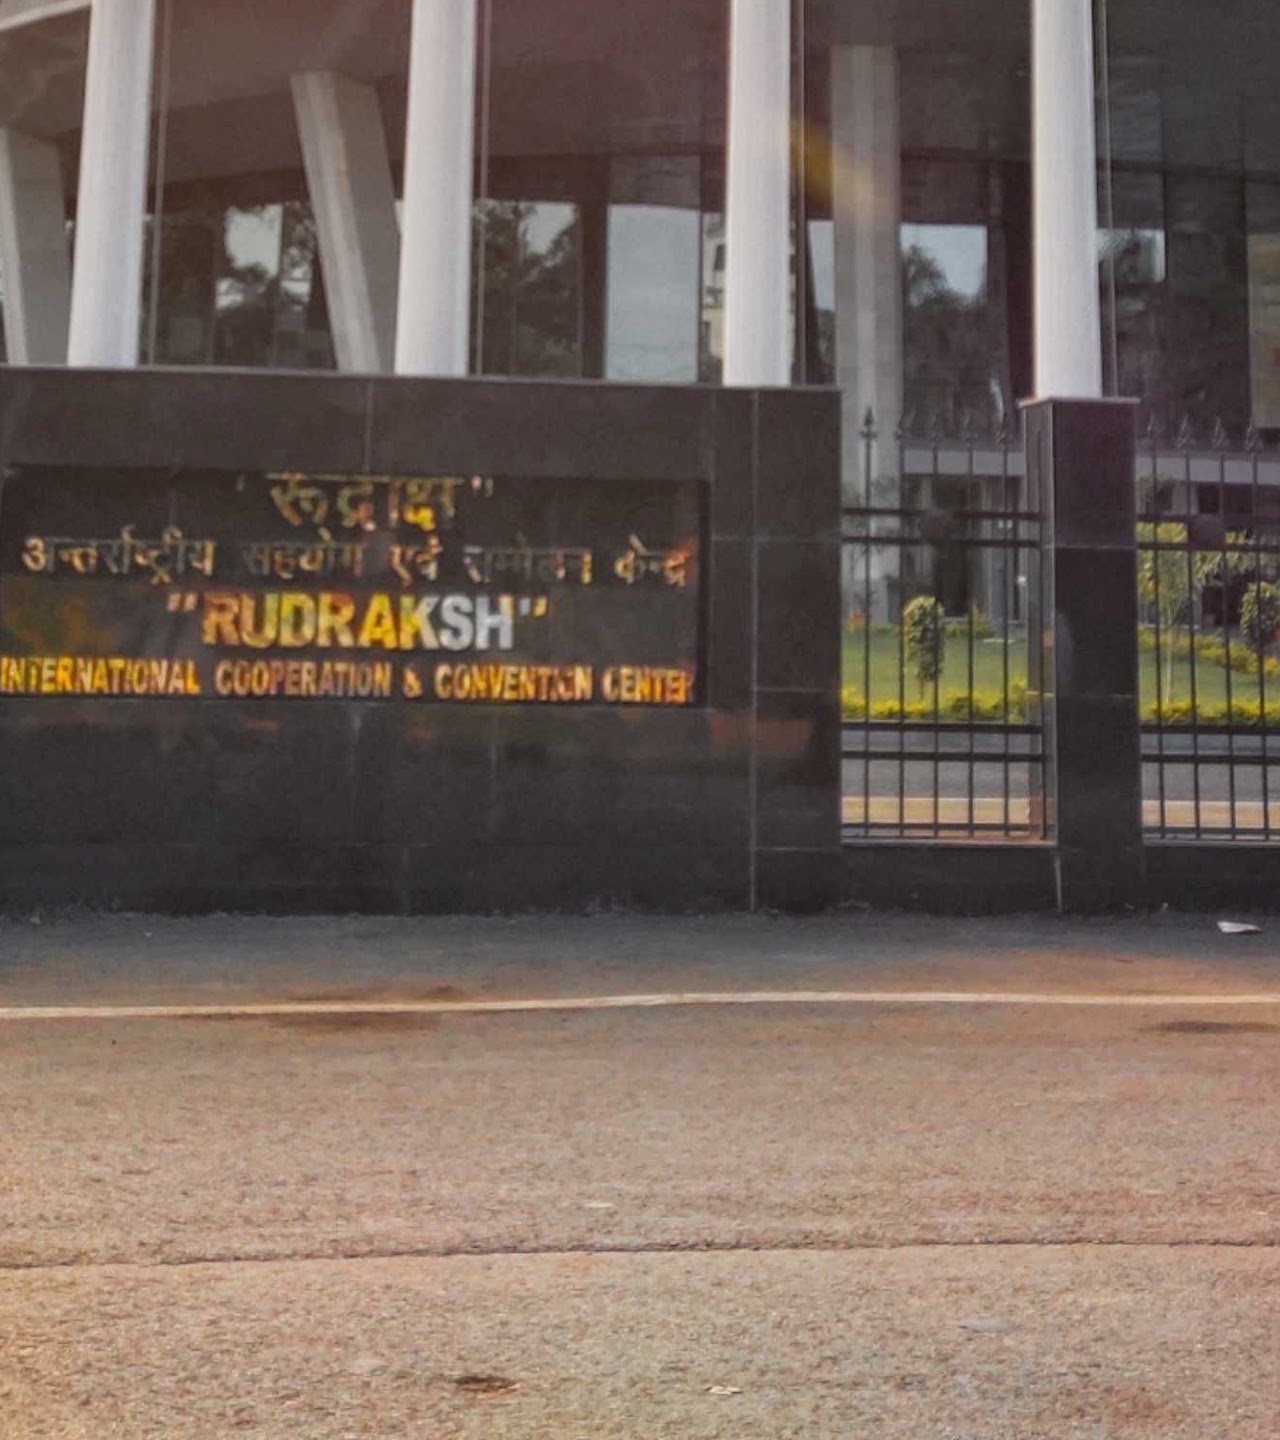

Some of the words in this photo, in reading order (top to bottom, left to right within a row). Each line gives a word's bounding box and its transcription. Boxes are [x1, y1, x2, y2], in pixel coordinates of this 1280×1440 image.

[242, 527, 363, 580] सहयोग
[390, 535, 443, 587] एवं
[166, 592, 549, 651] "RUDRAKSH"
[214, 659, 393, 698] COOPERATION
[402, 664, 423, 699] &
[433, 663, 594, 701] CONVENTION
[602, 665, 694, 704] CENTER
